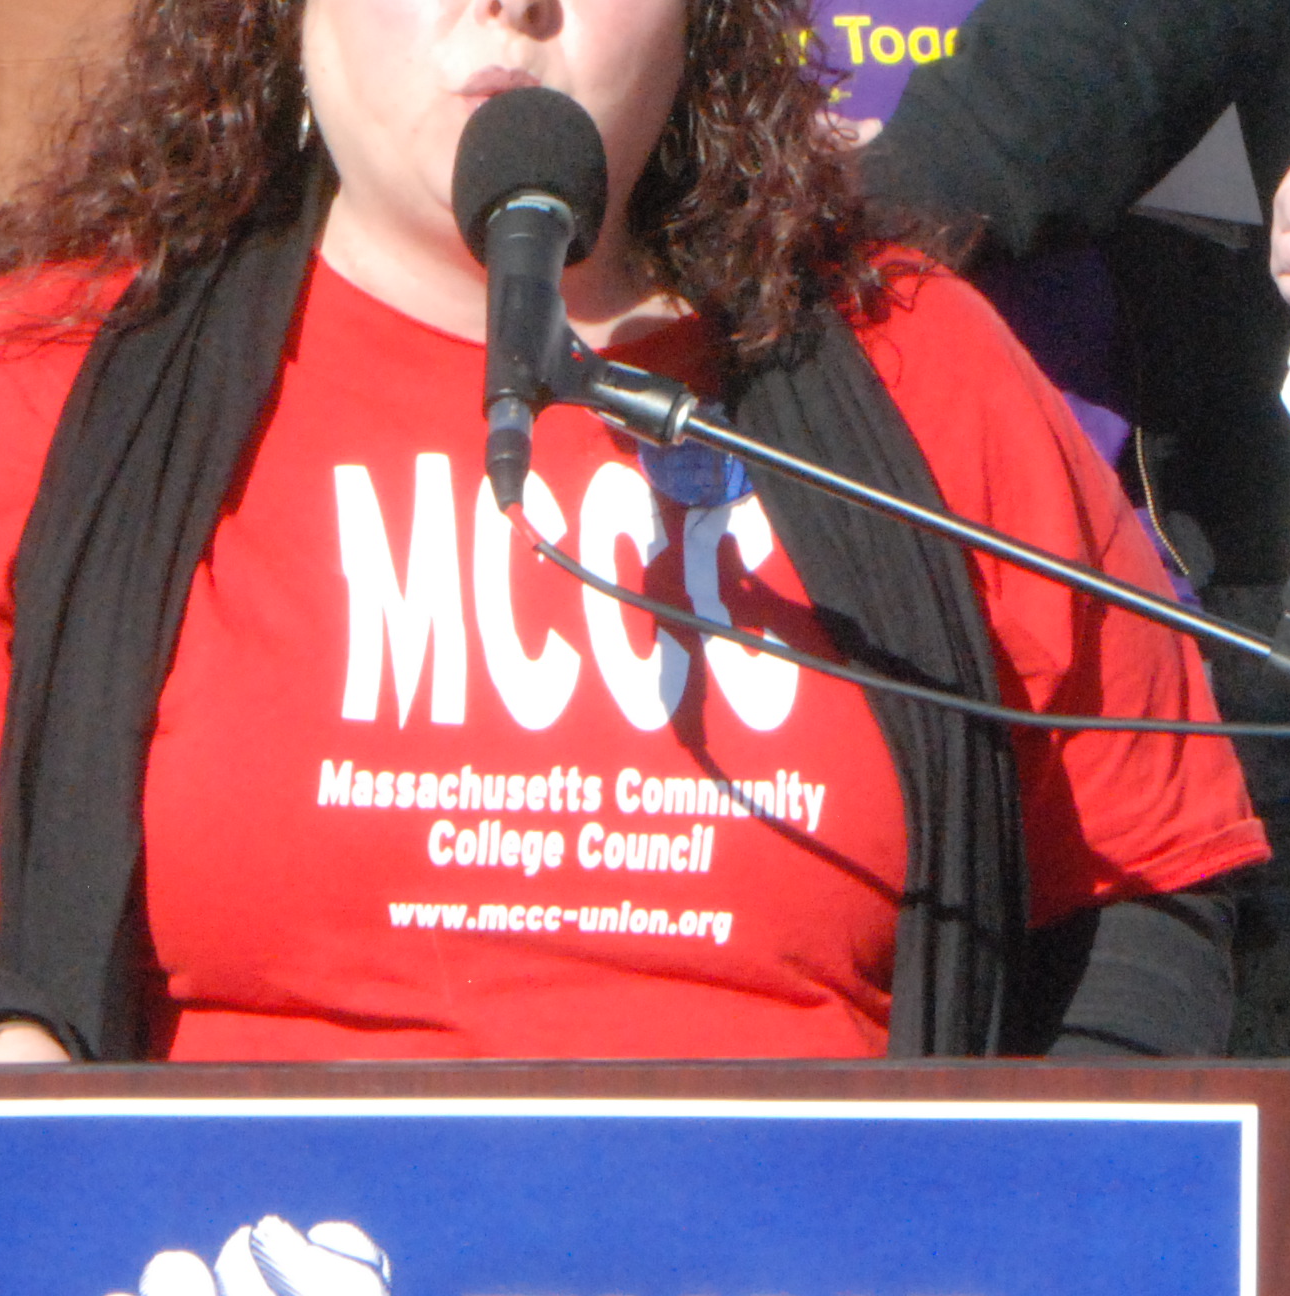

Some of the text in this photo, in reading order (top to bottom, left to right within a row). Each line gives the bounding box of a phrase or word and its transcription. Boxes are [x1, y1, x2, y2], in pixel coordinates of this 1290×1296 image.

[333, 452, 801, 732] MCCC
[317, 759, 825, 832] Massachusetts Community
[427, 820, 715, 877] College Council
[389, 900, 734, 944] www.mccc-union.org
